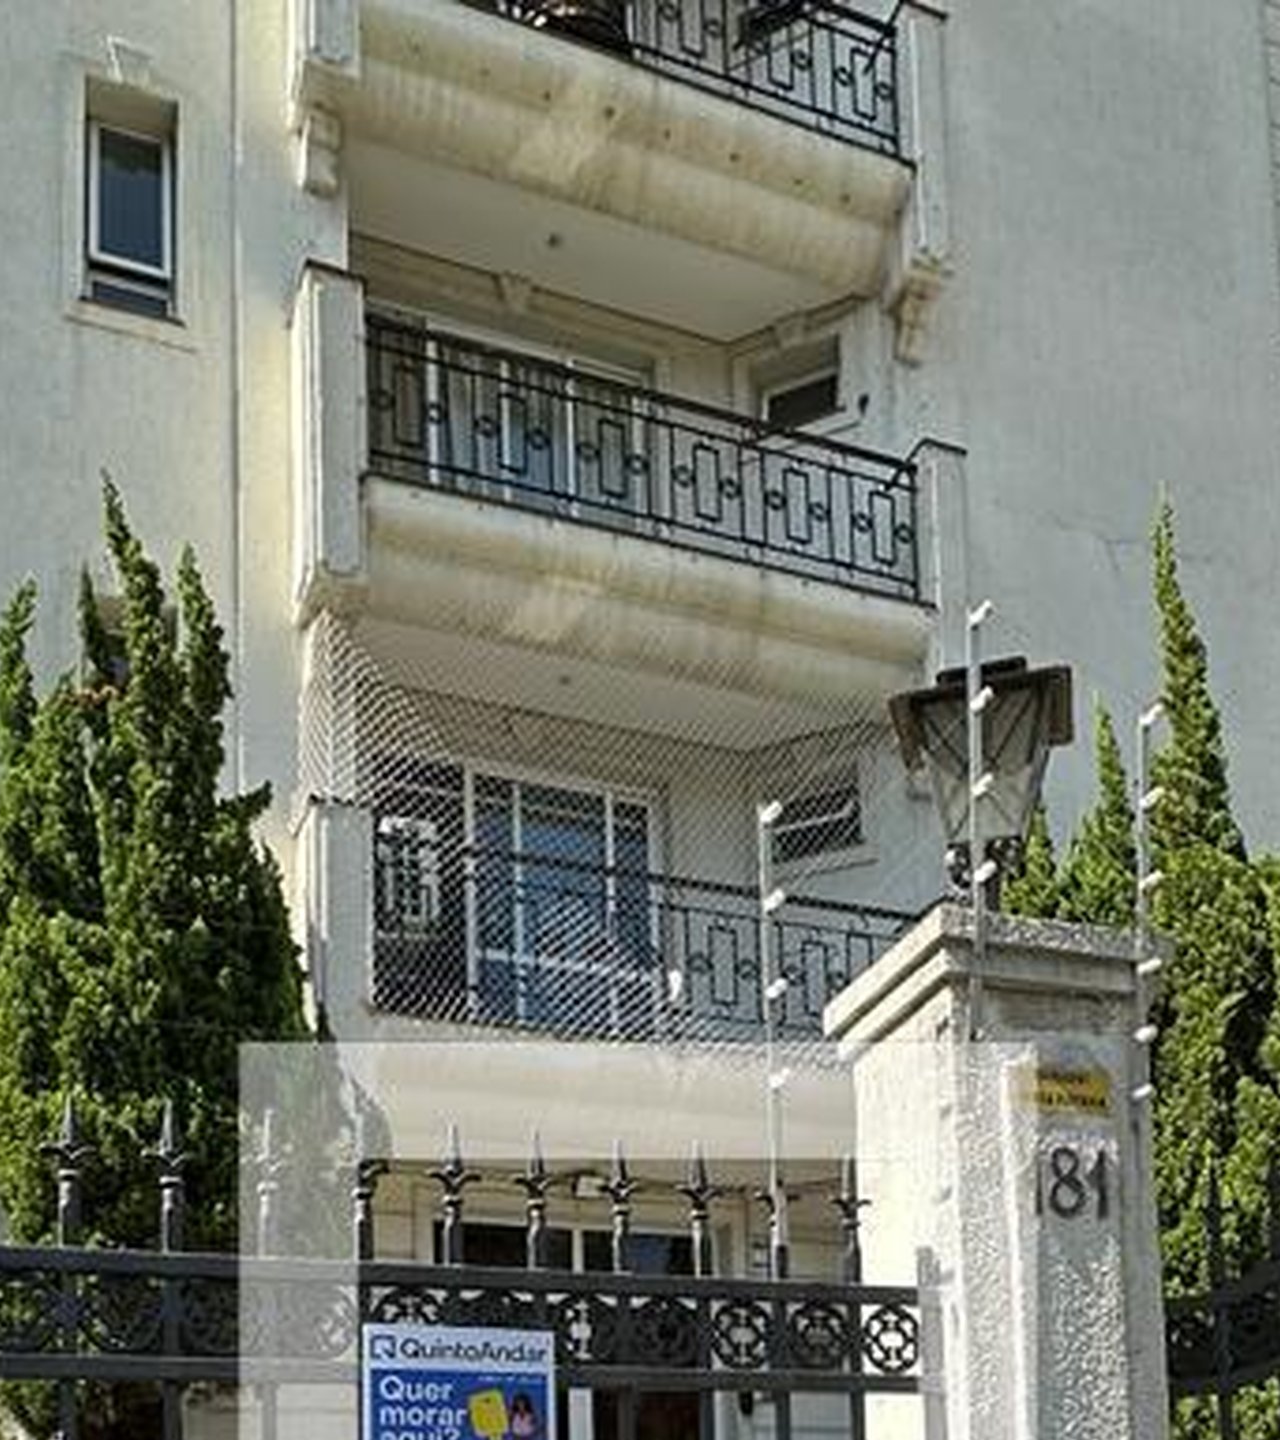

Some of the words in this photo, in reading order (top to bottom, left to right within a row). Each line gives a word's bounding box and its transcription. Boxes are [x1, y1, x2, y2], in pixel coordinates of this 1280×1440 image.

[399, 1337, 547, 1362] QuintoAndar
[379, 1375, 453, 1401] Quer
[379, 1406, 467, 1426] morar
